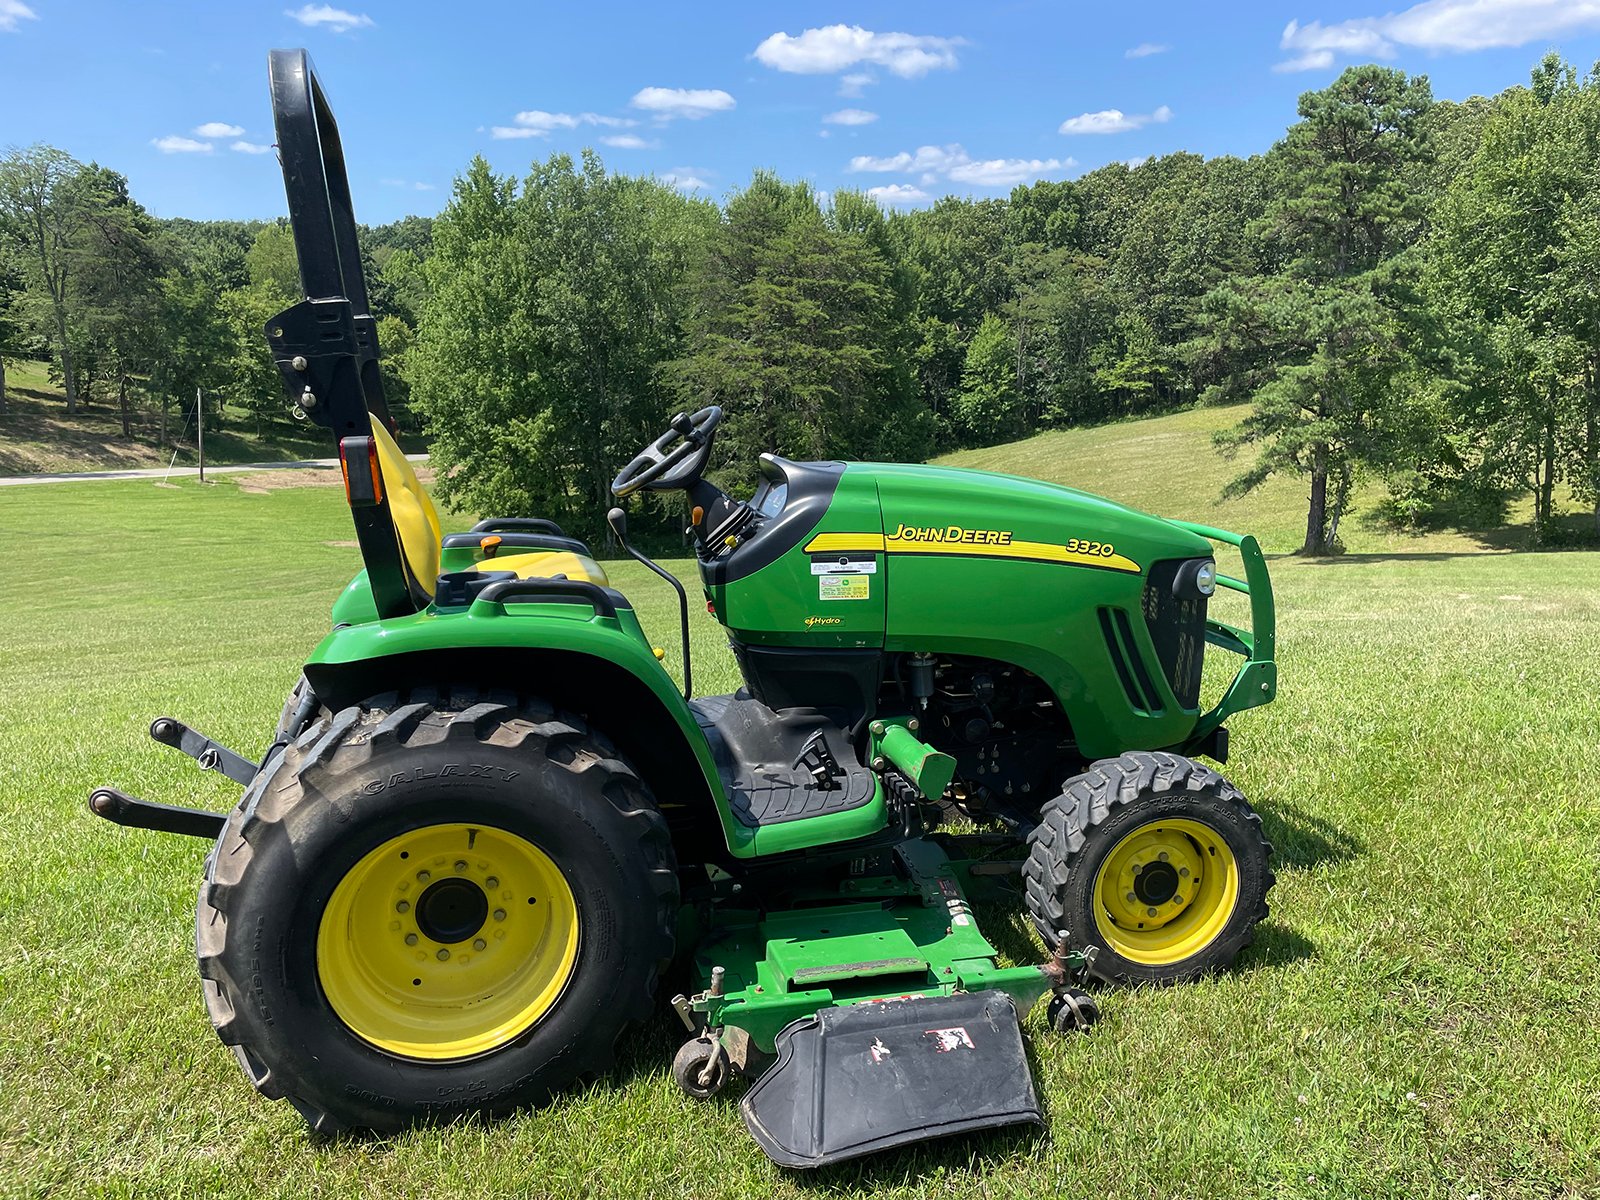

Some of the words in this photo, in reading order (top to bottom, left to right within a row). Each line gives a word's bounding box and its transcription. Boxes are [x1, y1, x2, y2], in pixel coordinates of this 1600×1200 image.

[888, 524, 944, 543] JOHN
[944, 526, 1012, 545] DEERE
[1065, 538, 1115, 558] 3320
[362, 763, 521, 796] GALAXY
[1102, 796, 1200, 835] INDUSTRIAL
[1211, 803, 1239, 825] LUG
